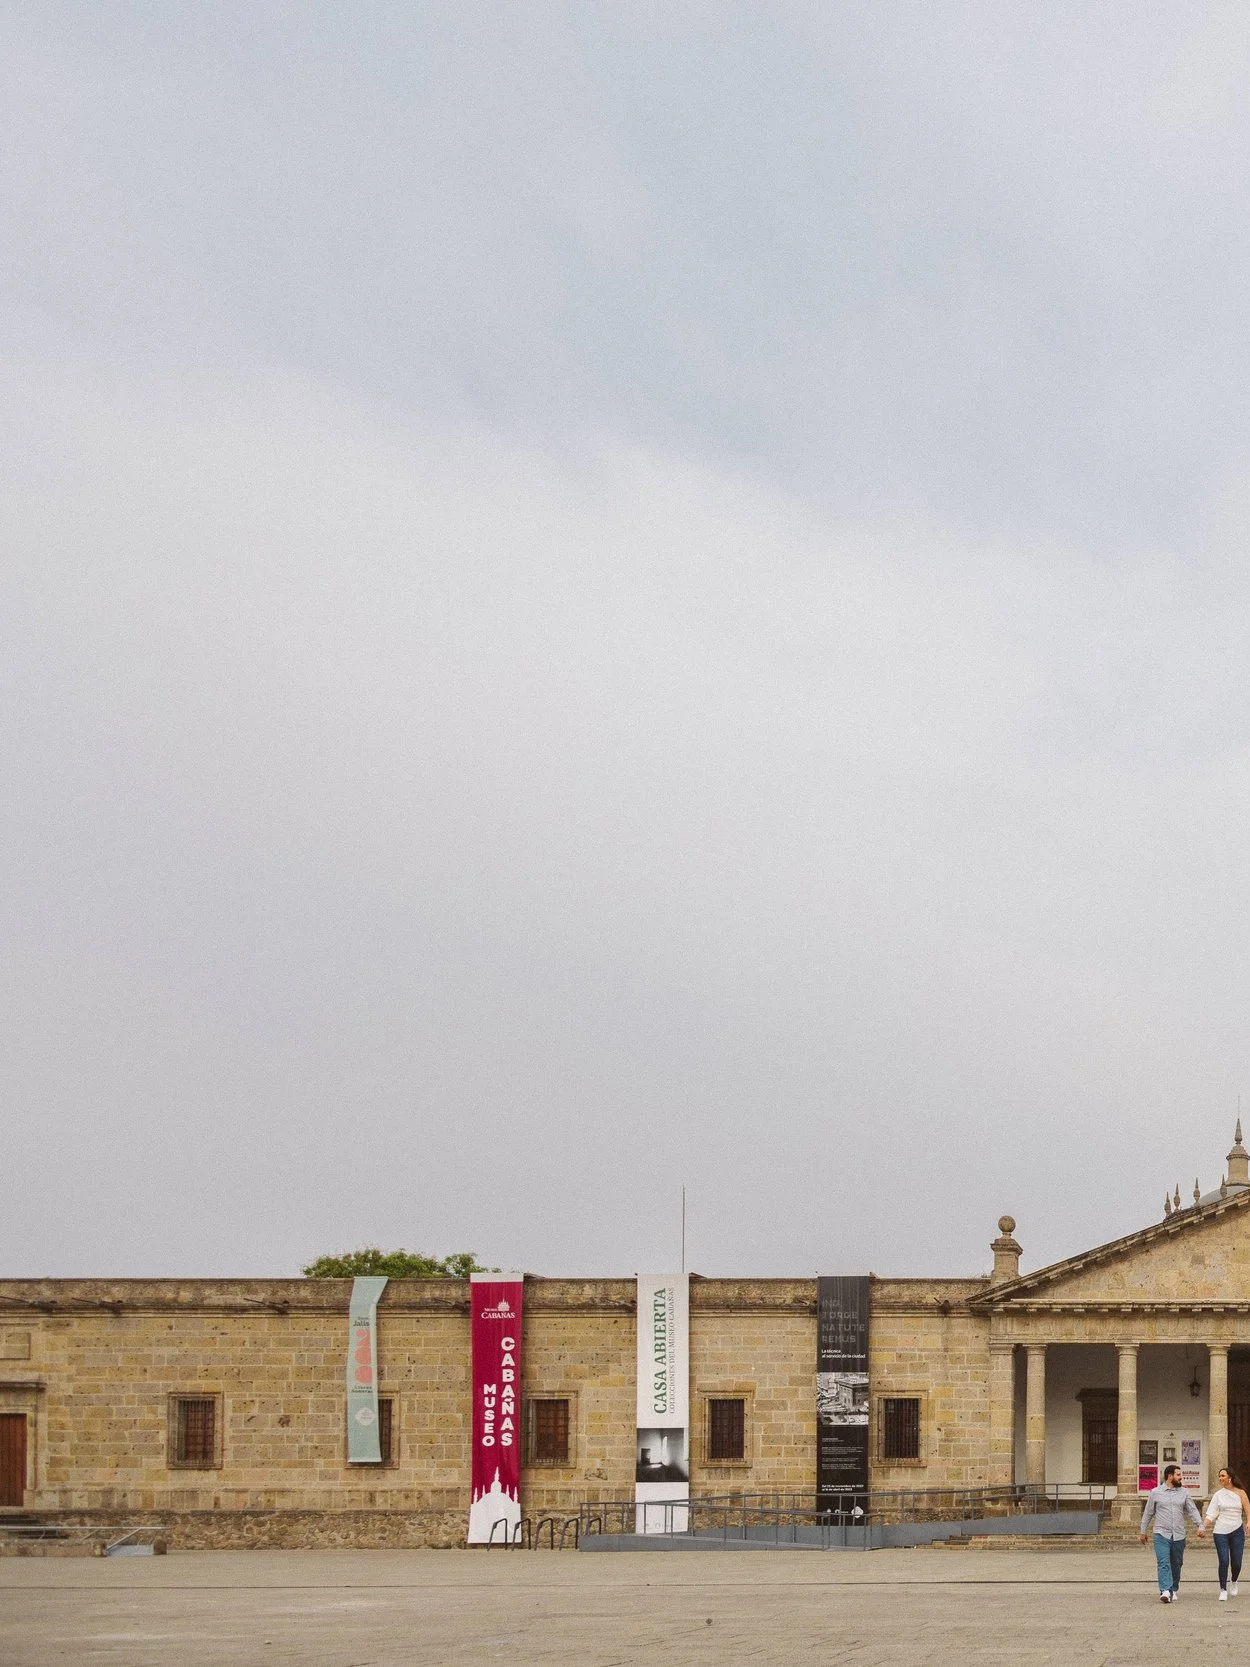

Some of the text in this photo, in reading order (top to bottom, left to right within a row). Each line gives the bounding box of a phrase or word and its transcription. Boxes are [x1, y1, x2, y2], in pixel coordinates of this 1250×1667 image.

[500, 1336, 516, 1447] CABAÑAS
[654, 1287, 667, 1414] CASA ABIERTA
[482, 1383, 497, 1447] MUSEO
